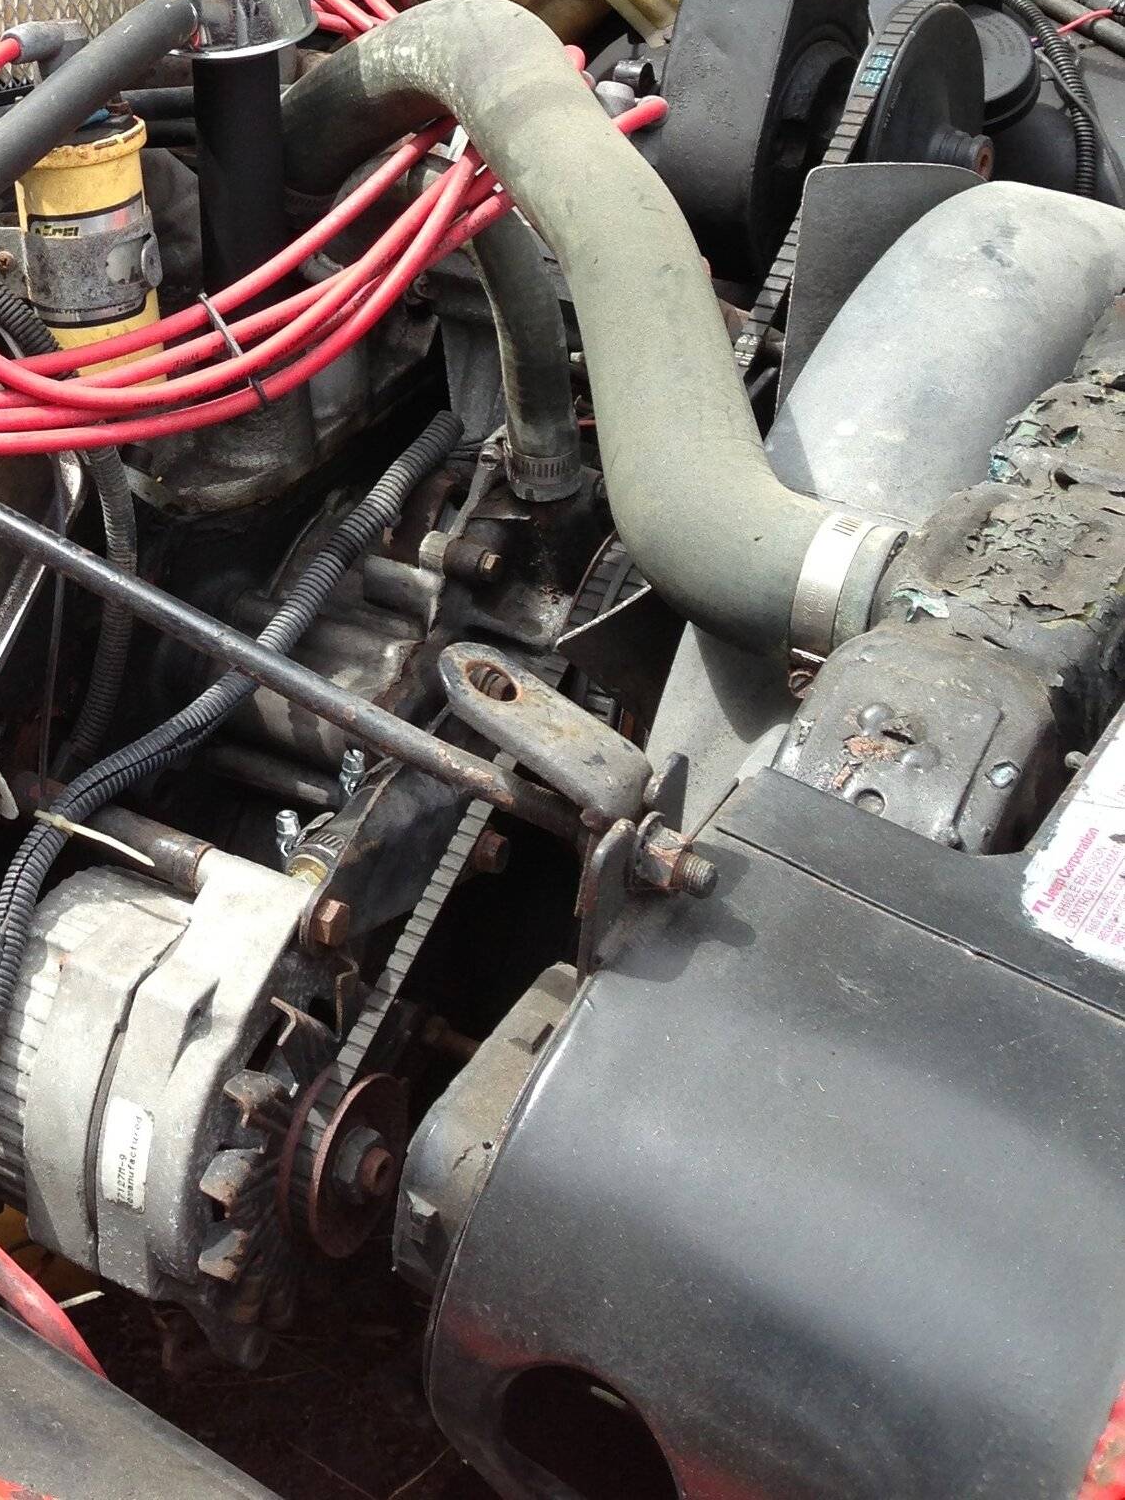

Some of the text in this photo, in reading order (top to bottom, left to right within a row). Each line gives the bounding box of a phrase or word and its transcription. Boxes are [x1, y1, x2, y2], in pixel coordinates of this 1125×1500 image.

[1043, 826, 1100, 902] Jeep Corporation
[127, 1115, 143, 1204] emanufactured
